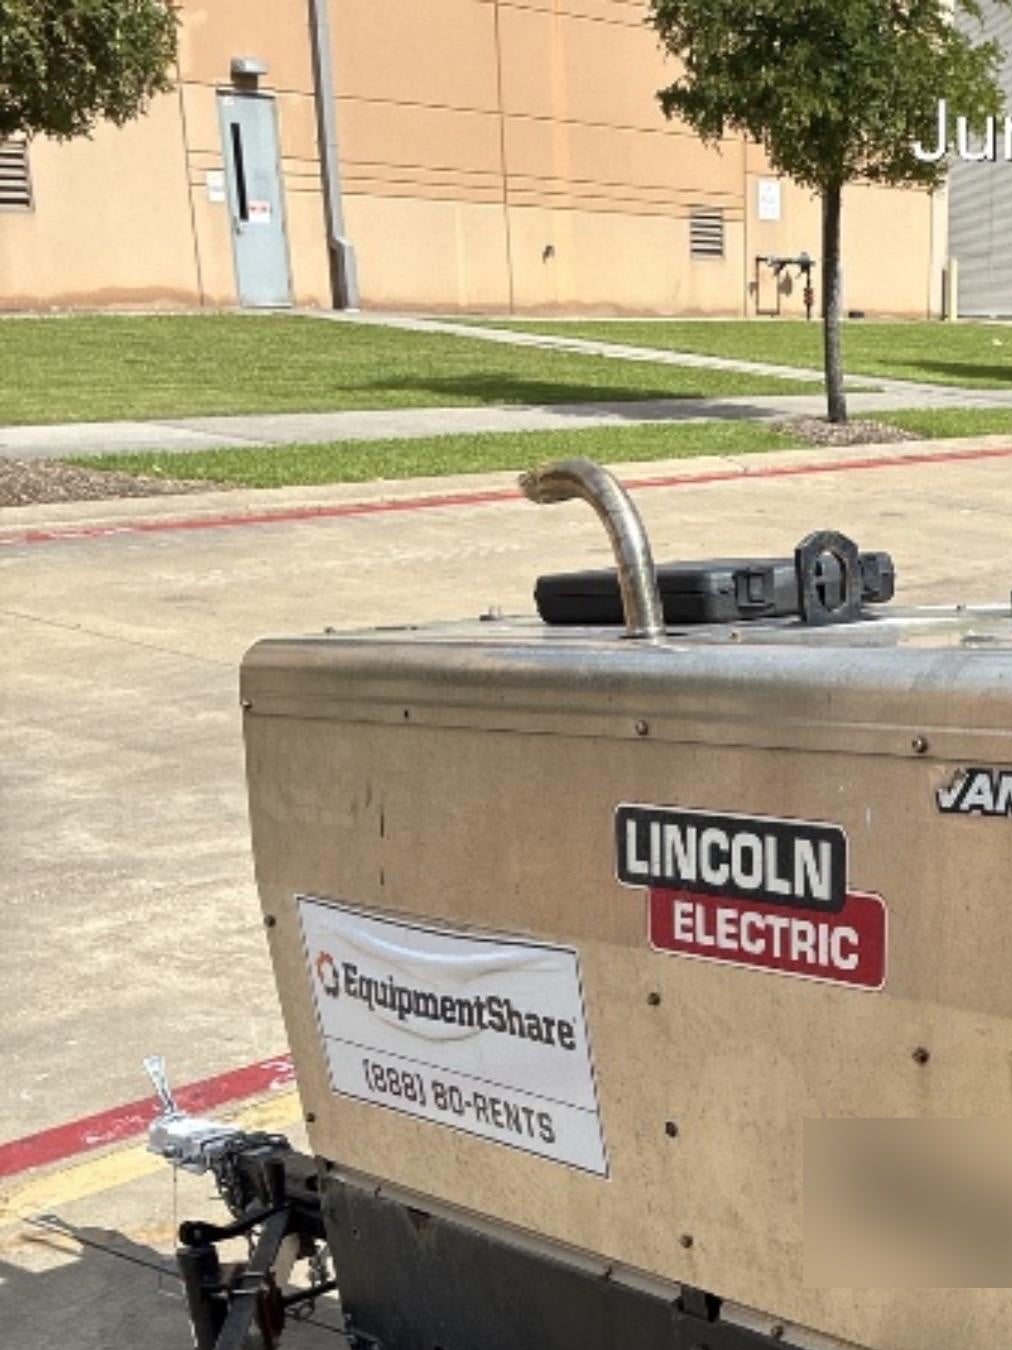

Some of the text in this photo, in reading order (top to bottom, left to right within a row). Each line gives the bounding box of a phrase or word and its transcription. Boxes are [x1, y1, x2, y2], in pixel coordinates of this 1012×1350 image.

[625, 817, 833, 901] LINCOLN
[673, 899, 860, 970] ELECTRIC
[340, 961, 577, 1051] EquipmentShare
[362, 1058, 556, 1144] (888) 80-RENTS
